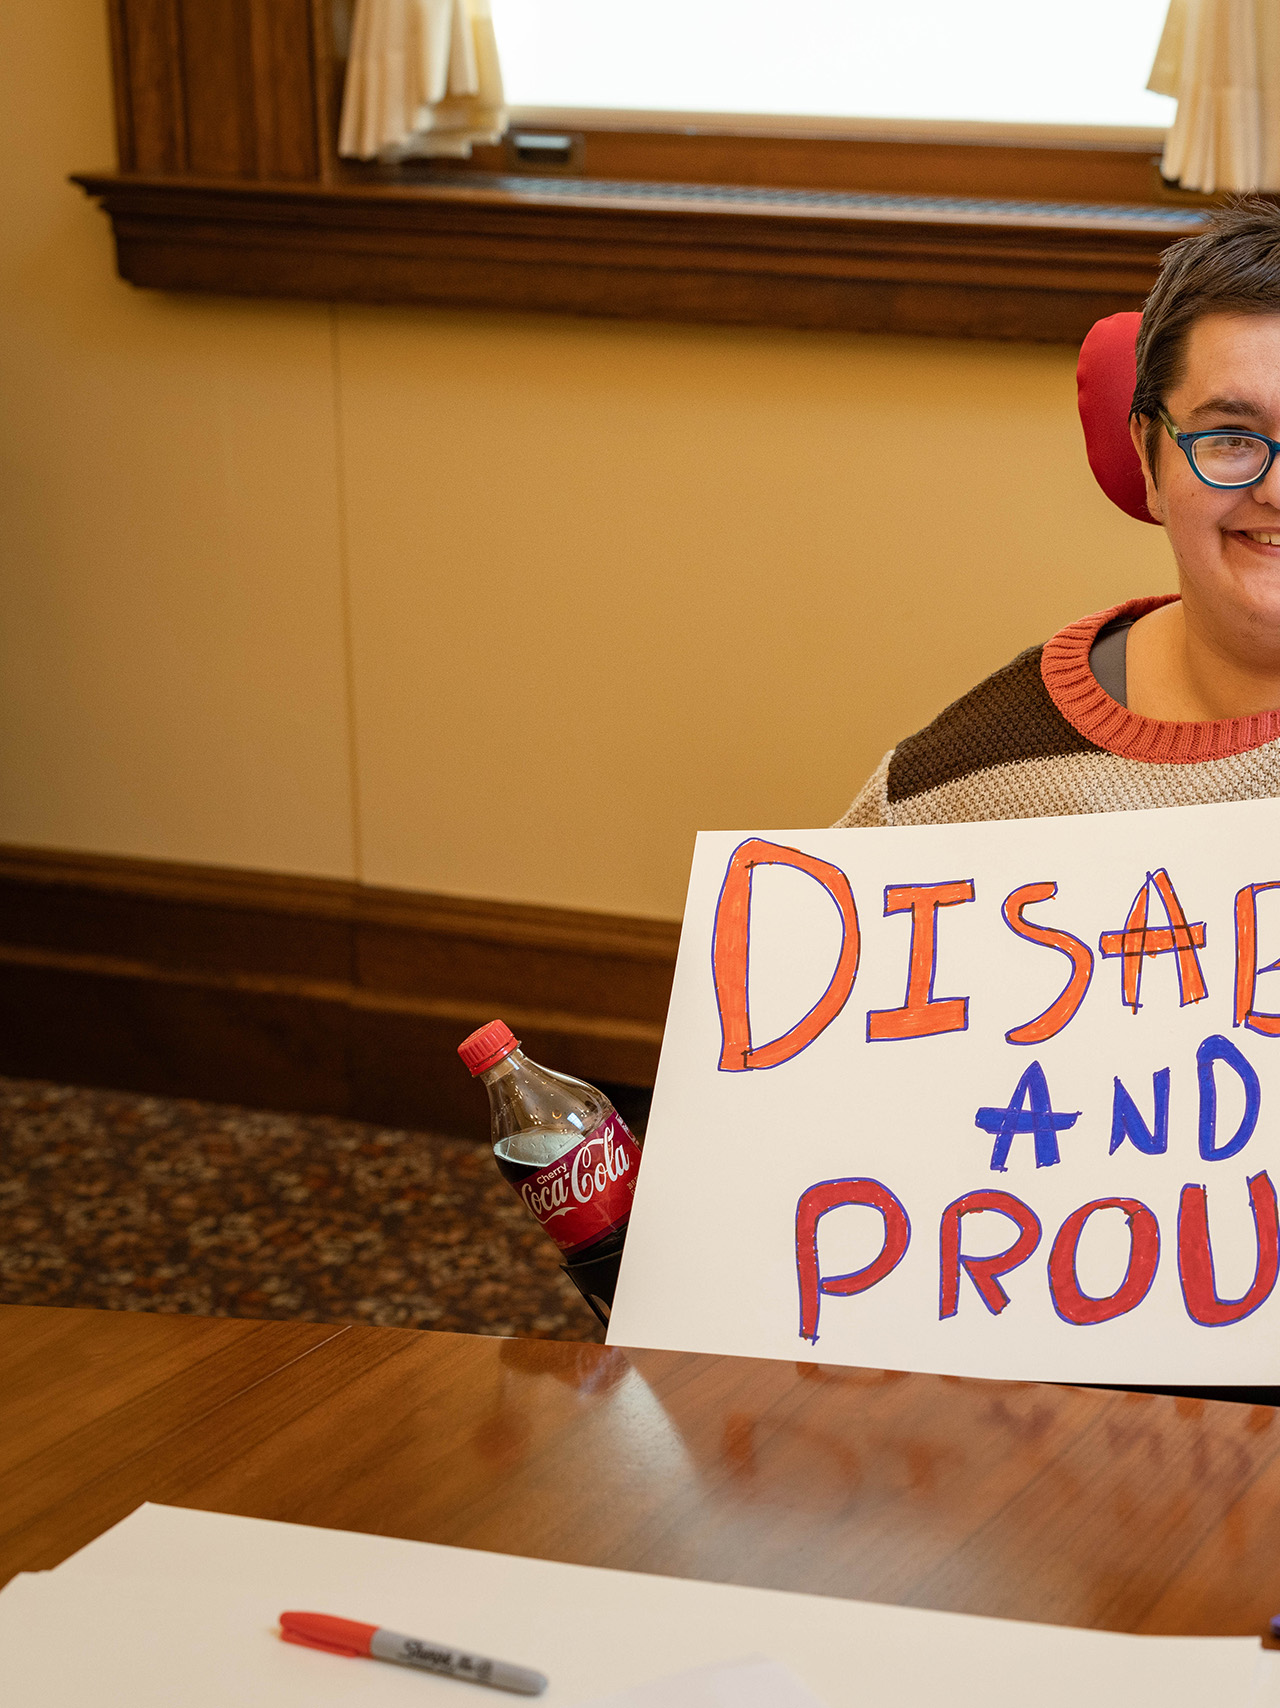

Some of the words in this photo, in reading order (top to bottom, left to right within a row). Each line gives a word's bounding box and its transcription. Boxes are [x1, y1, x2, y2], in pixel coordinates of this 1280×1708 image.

[974, 1034, 1262, 1173] AND
[521, 1121, 630, 1224] Coca-Cola
[536, 1162, 568, 1186] Cherry
